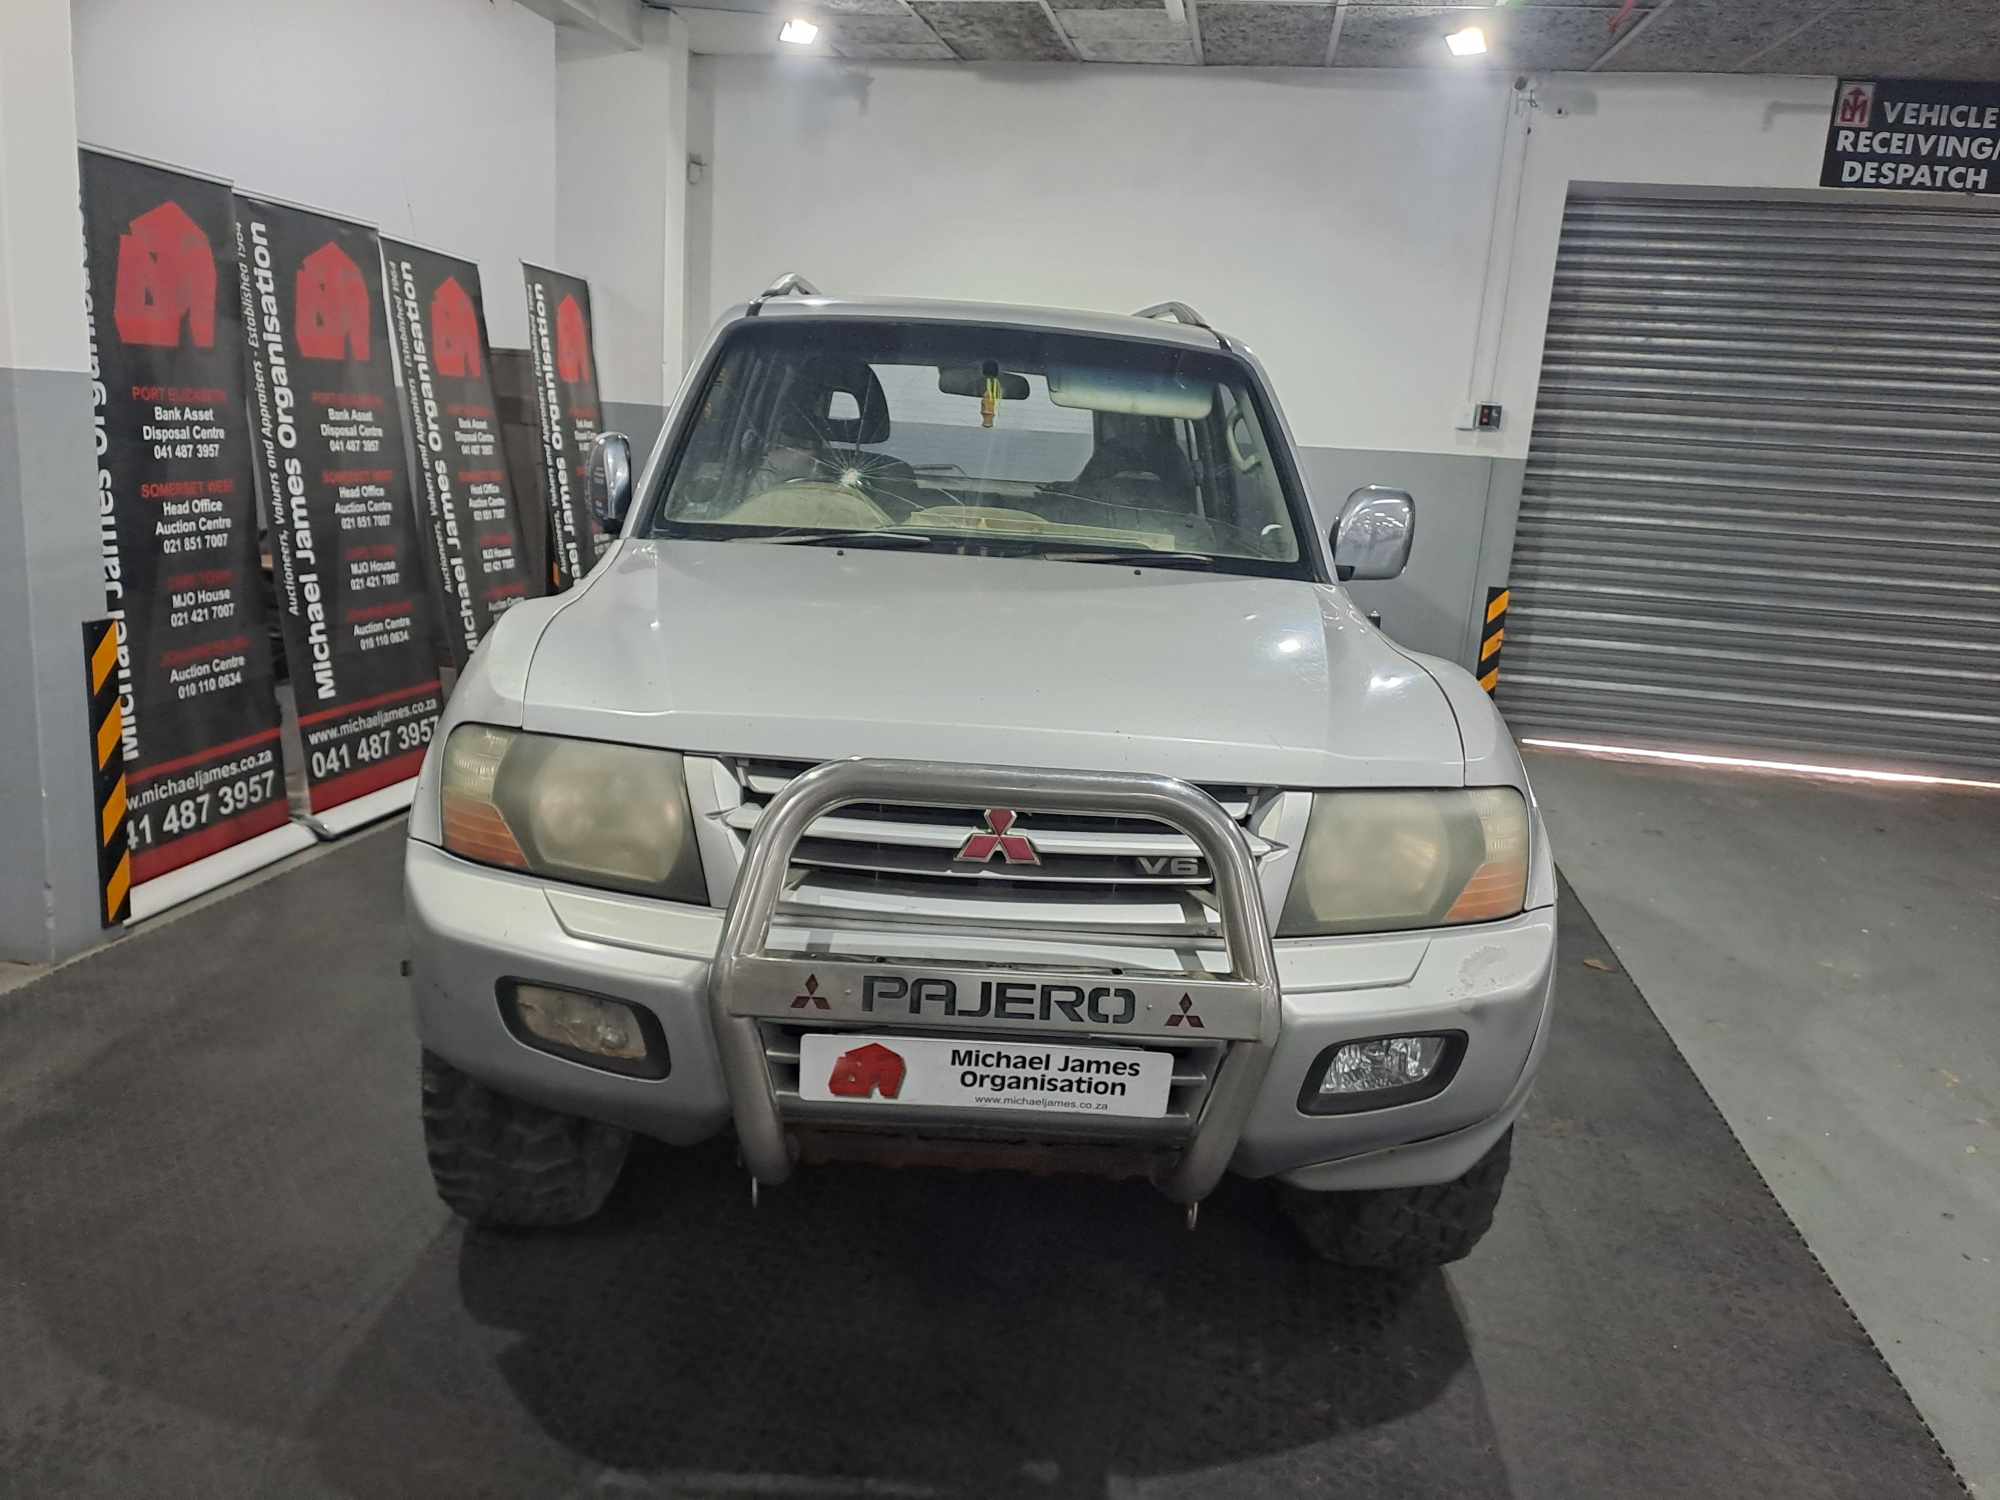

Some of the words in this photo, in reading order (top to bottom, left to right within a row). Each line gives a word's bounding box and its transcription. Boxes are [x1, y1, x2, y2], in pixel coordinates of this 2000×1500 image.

[1883, 101, 2000, 129] VEHICLE
[1841, 161, 1988, 189] DESPATCH
[238, 264, 260, 349] Established
[250, 221, 297, 450] Organisation
[400, 260, 443, 452] Organisation
[534, 283, 563, 451] Organisation
[252, 359, 273, 438] Appraisers
[154, 406, 181, 421] Bank
[183, 406, 214, 421] Asset
[142, 425, 190, 442] Disposal
[192, 425, 225, 440] Centre
[154, 444, 172, 459] 041
[175, 444, 194, 458] 487
[196, 443, 220, 458] 3957
[262, 439, 280, 470] and
[162, 500, 190, 516] Head
[191, 498, 223, 513] Office
[270, 472, 286, 526] Valuers
[285, 457, 316, 565] James
[334, 502, 366, 514] Auction
[434, 459, 462, 551] James
[555, 457, 576, 537] James
[155, 520, 197, 535] Auction
[198, 516, 232, 531] Centre
[163, 538, 181, 554] 021
[184, 536, 202, 551] 851
[204, 533, 228, 549] 7007
[278, 529, 300, 616] Auctioneers,
[172, 591, 195, 609] MJO
[197, 588, 231, 604] House
[170, 611, 188, 628] 021
[190, 608, 209, 623] 421
[211, 603, 235, 619] 7007
[299, 572, 337, 700] Michael
[169, 663, 210, 684] Auction
[212, 655, 246, 673] Centre
[178, 684, 197, 700] 010
[198, 677, 217, 693] 110
[307, 698, 437, 745] www.michaeljames.co.za
[311, 742, 351, 778] 041
[356, 729, 391, 762] 487
[396, 715, 440, 750] 3957
[126, 812, 153, 851] 41
[162, 793, 211, 835] 487
[217, 769, 275, 815] 3957
[1136, 856, 1199, 876] V6
[862, 975, 1136, 1025] PAJERO
[950, 1049, 1051, 1072] Michael
[1057, 1055, 1141, 1077] James
[959, 1071, 1127, 1097] Organisation
[974, 1094, 1109, 1111] www.michaeljames.co.za
